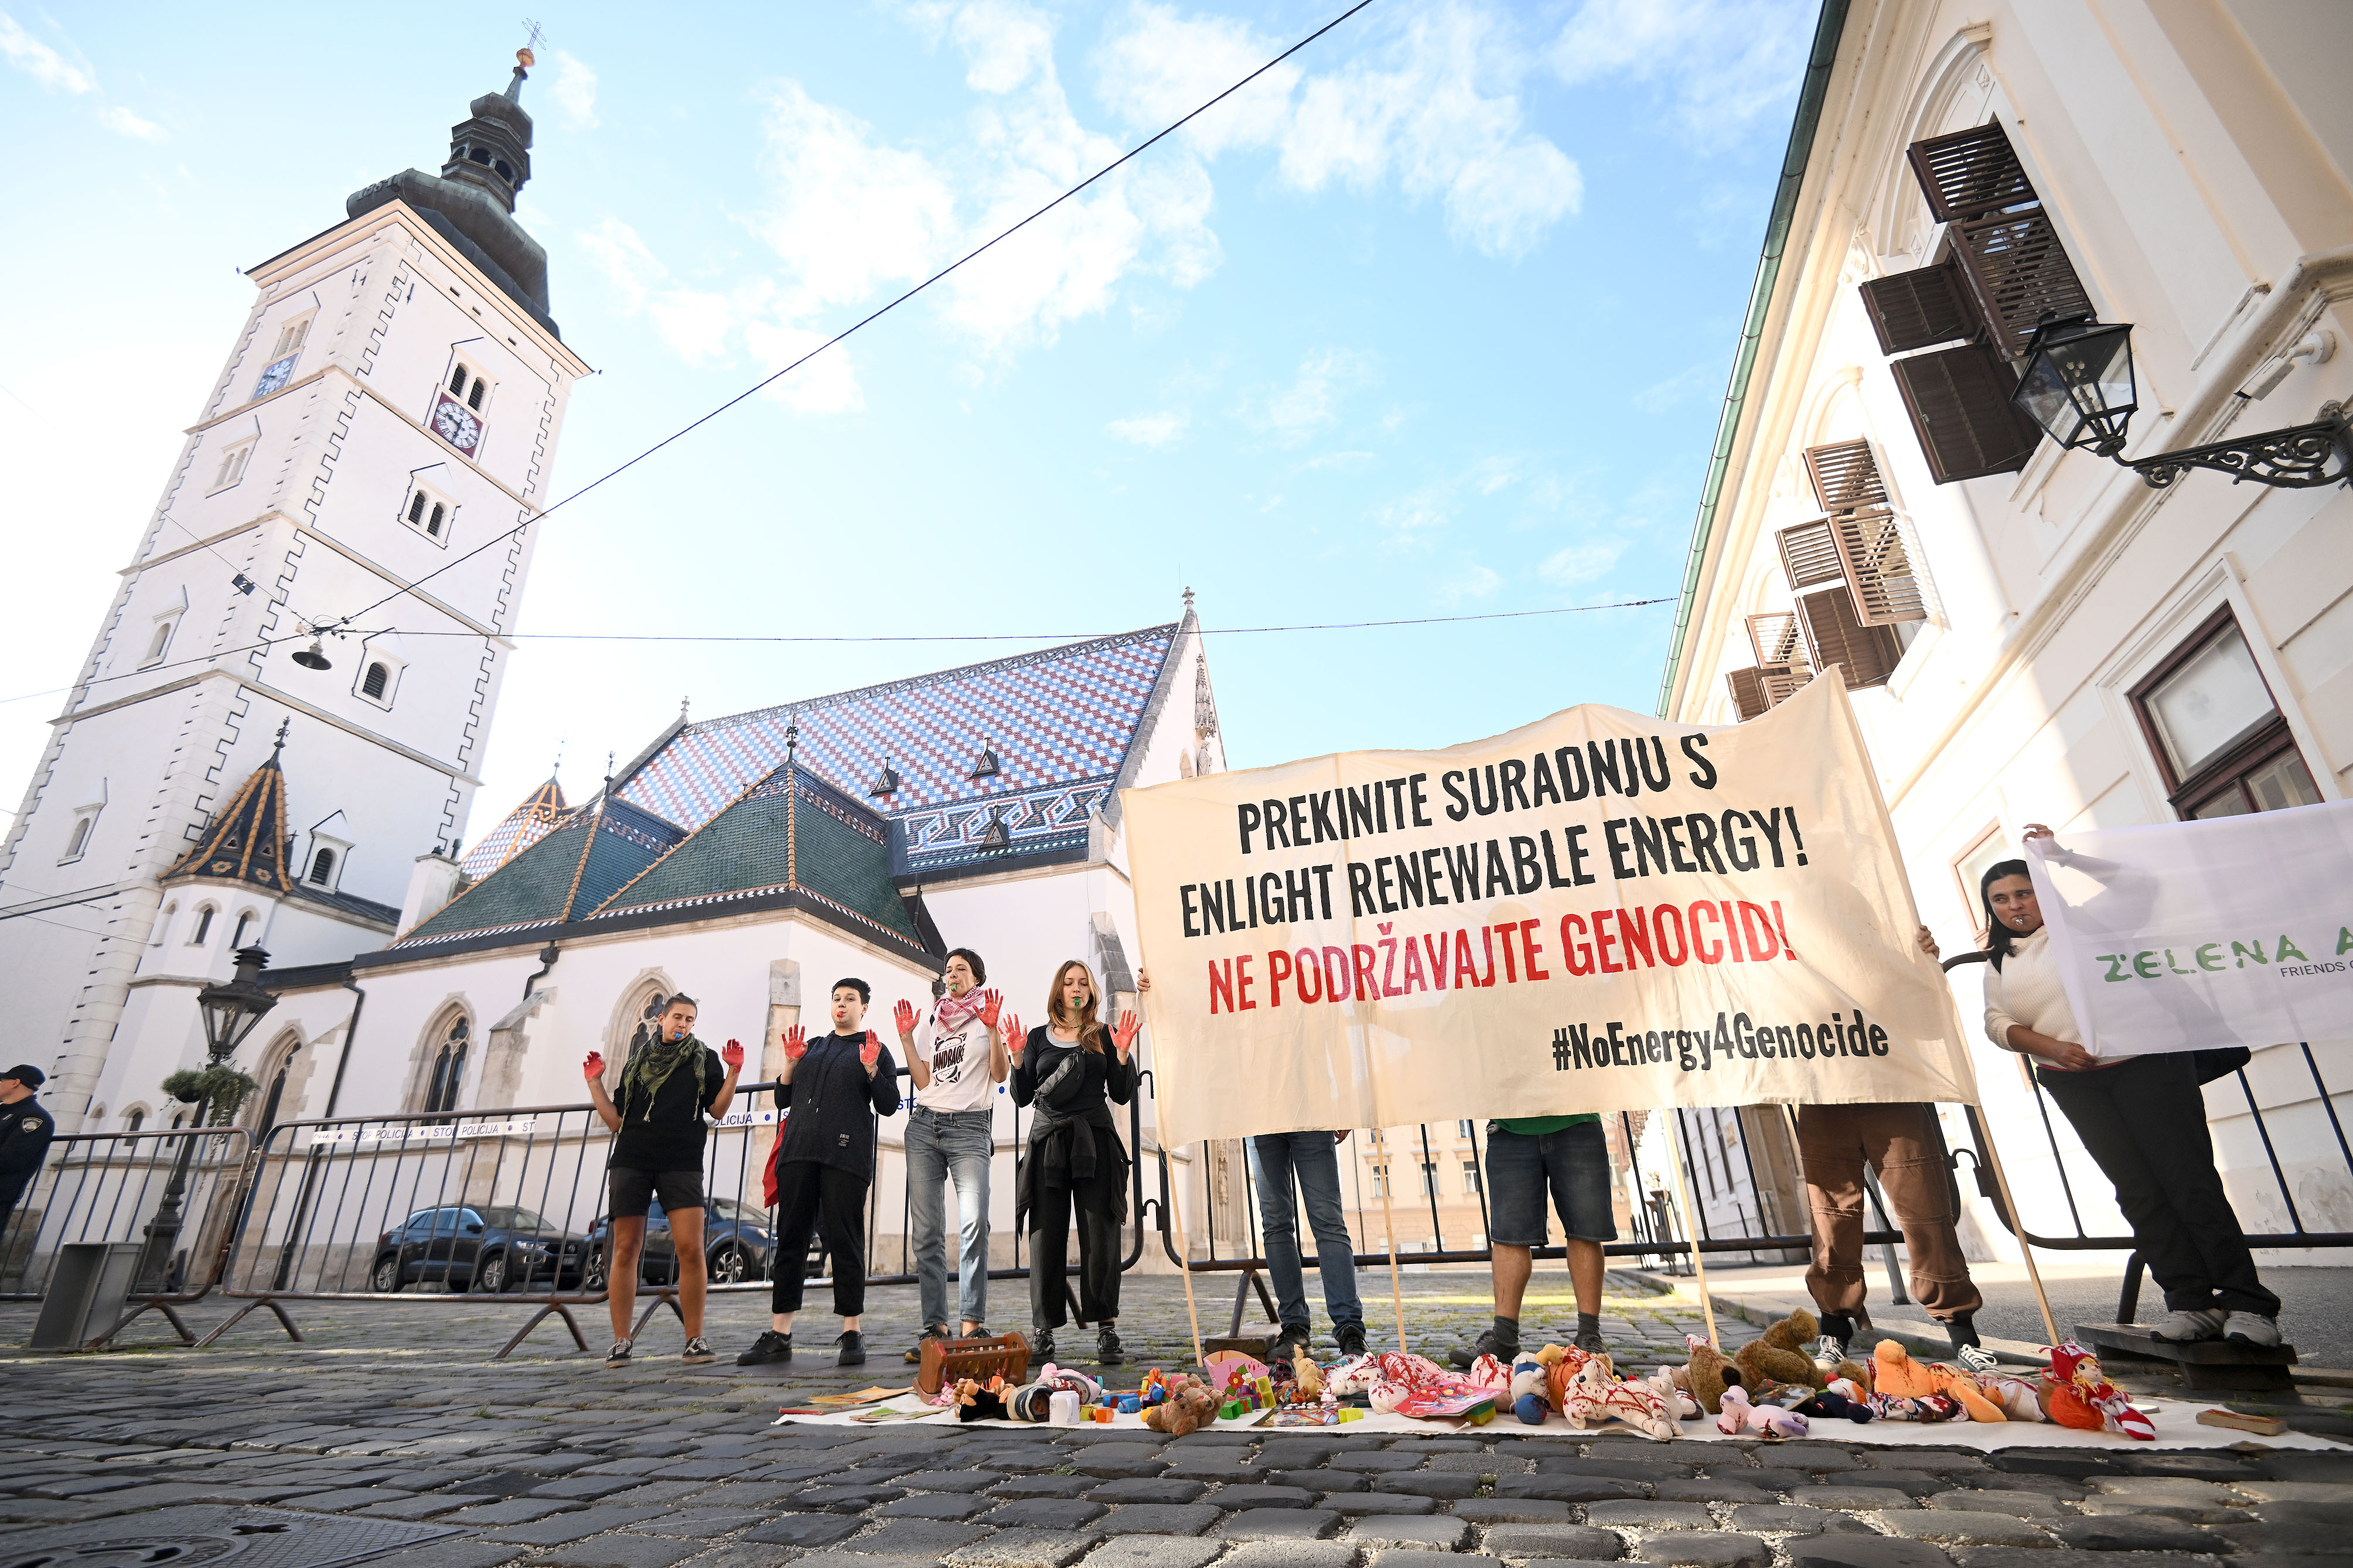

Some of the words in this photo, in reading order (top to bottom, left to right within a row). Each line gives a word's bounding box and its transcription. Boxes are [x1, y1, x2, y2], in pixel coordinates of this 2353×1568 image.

[1237, 773, 1433, 855] PREKINITE
[1441, 736, 1671, 822] SURADNJU
[1680, 733, 1718, 790] S
[1179, 862, 1334, 938] ENLIGHT
[1347, 825, 1596, 918] RENEWABLE
[1602, 806, 1809, 880] ENERGY!
[1208, 954, 1257, 1015] NE
[1267, 918, 1550, 1008] PODRŽAVAJTE
[1560, 900, 1798, 977] GENOCID!
[2095, 934, 2309, 983] ZELENA
[2280, 962, 2346, 978] FRIENDS
[1552, 1009, 1889, 1072] #NoEnergy4Genocide
[376, 1129, 413, 1139] POLICIA
[434, 1127, 455, 1137] STO
[462, 1124, 499, 1135] POLICIJA
